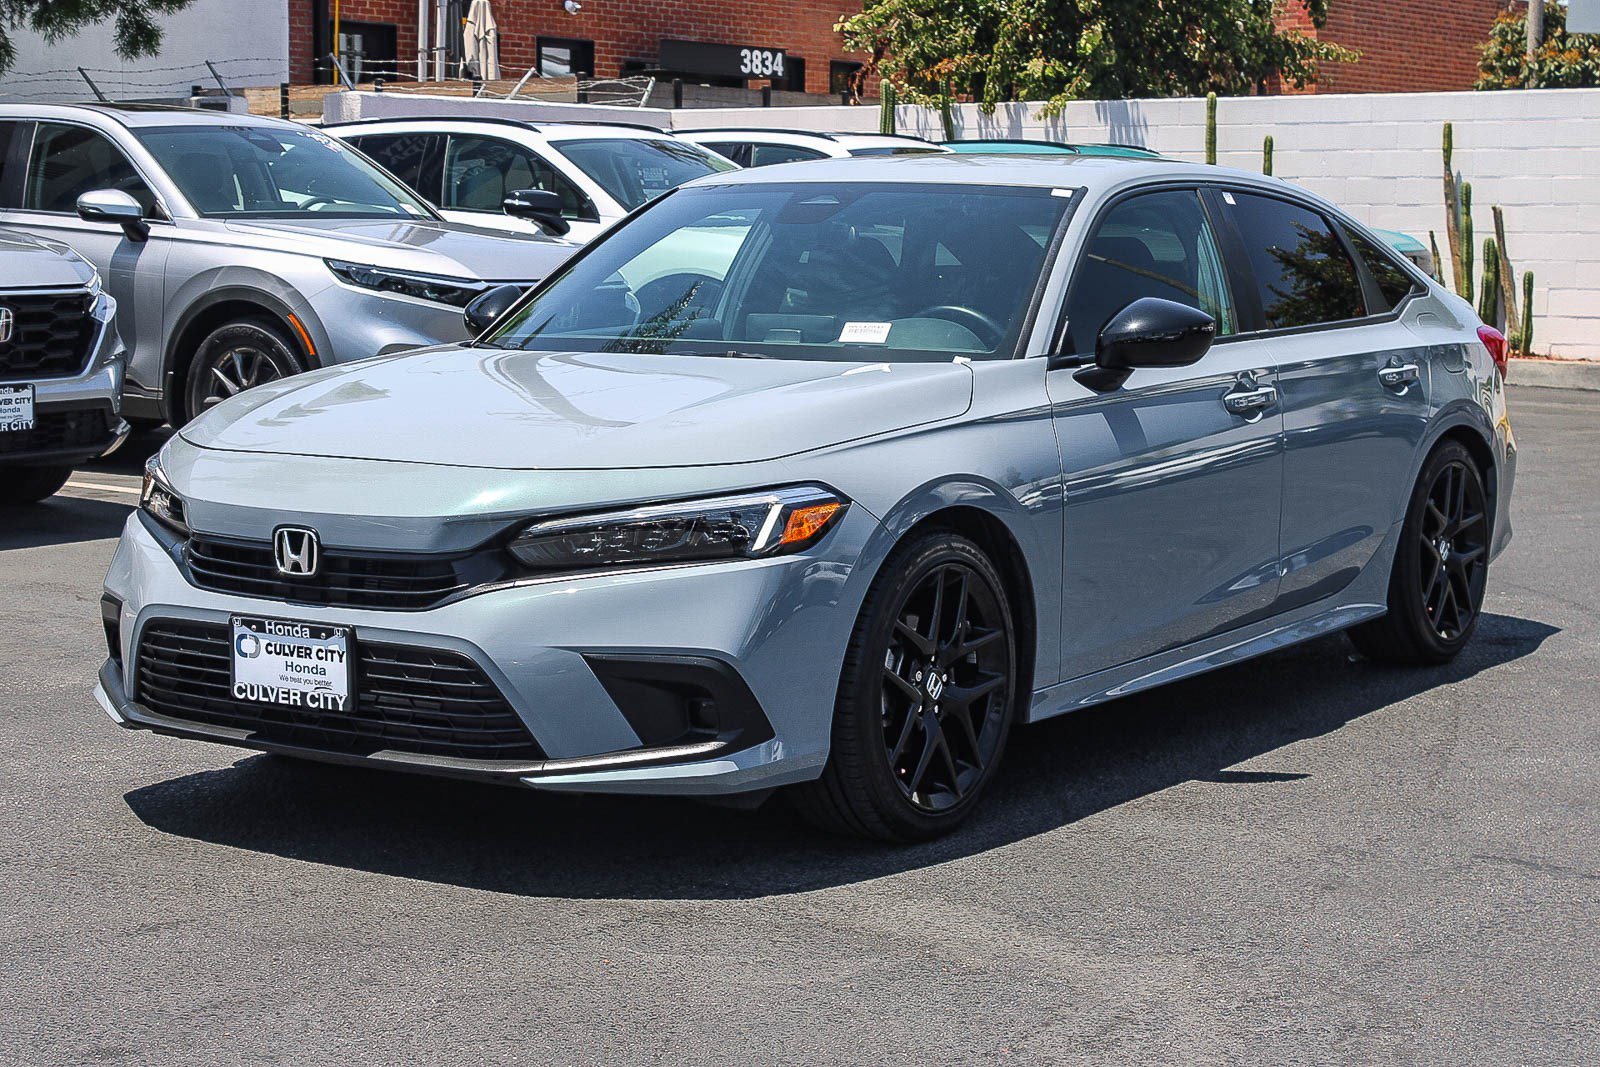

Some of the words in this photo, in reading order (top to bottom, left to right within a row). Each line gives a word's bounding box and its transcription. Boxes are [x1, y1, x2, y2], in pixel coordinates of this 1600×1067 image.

[740, 49, 784, 76] 3834
[15, 397, 31, 405] CITY
[11, 420, 34, 431] CITY
[265, 620, 310, 638] Honda
[265, 642, 312, 660] CULVER
[316, 648, 345, 663] CITY
[285, 661, 327, 676] Honda
[279, 674, 289, 682] We
[289, 675, 302, 684] treat
[302, 678, 314, 686] you
[233, 682, 302, 706] CULVER
[306, 691, 348, 711] CITY
